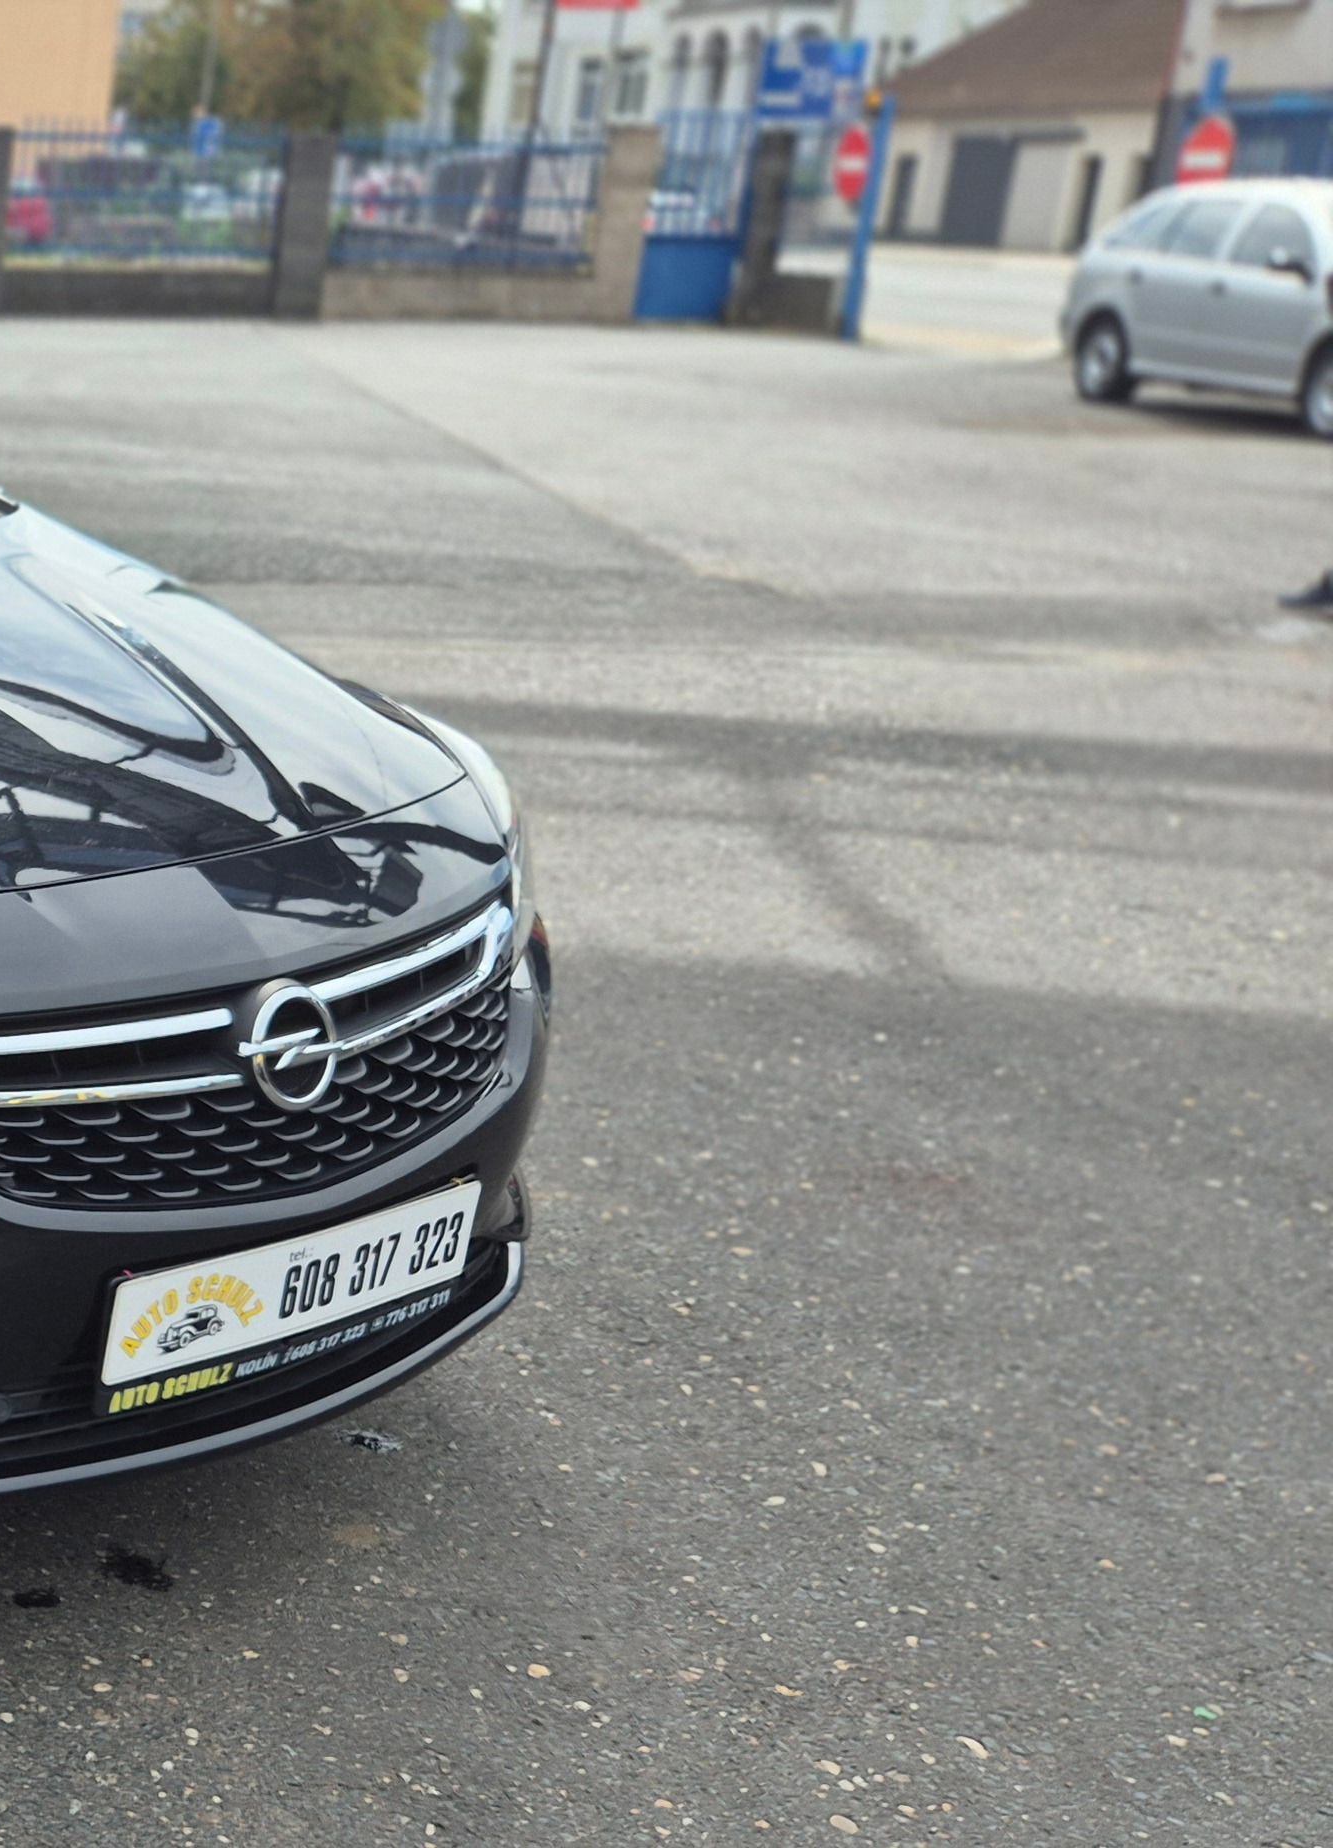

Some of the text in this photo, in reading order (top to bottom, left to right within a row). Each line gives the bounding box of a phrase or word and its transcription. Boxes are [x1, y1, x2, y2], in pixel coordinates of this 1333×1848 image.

[278, 1210, 465, 1319] 608 317 323
[120, 1272, 266, 1359] AUTO SCHULZ
[108, 1381, 160, 1414] AUTO
[161, 1362, 233, 1400] SCHULZ
[234, 1351, 278, 1379] KOLÍN
